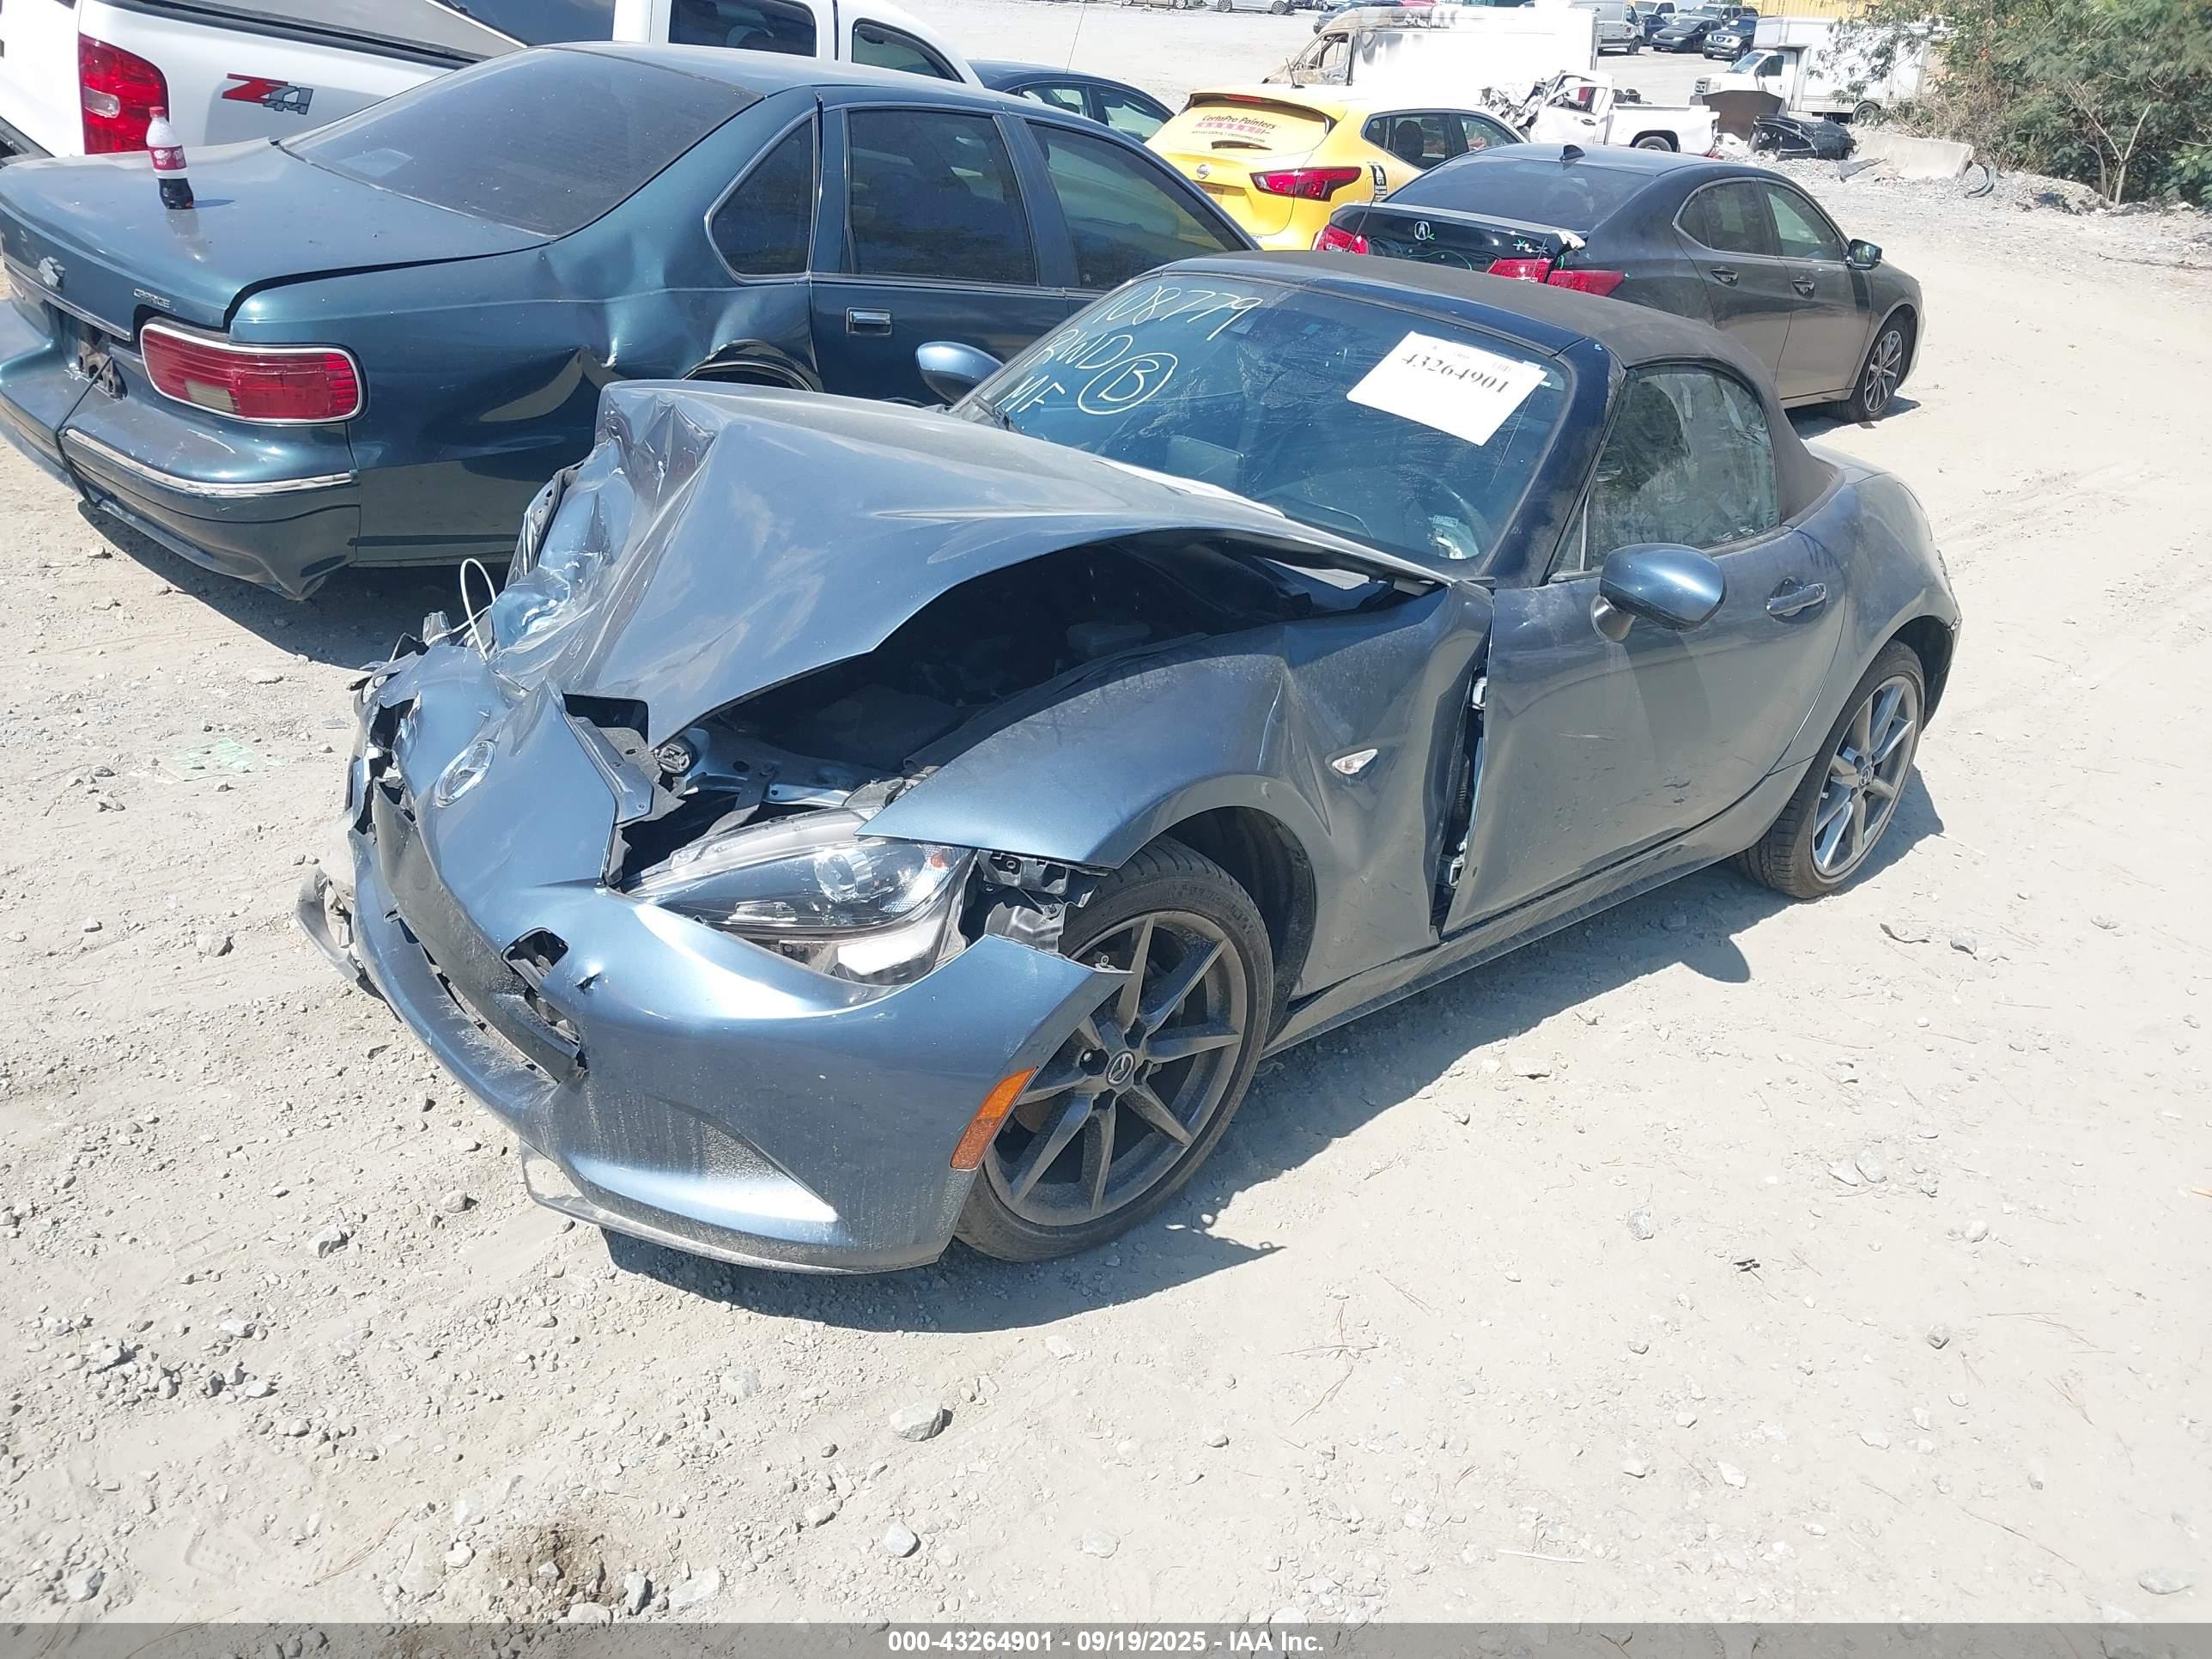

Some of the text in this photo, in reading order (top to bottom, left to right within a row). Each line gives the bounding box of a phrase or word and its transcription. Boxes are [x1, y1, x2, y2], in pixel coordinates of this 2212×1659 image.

[221, 72, 314, 106] Z71
[1238, 117, 1278, 130] Painters
[1024, 329, 1133, 370] RWD
[1098, 358, 1159, 402] B
[1401, 353, 1510, 394] 43264901
